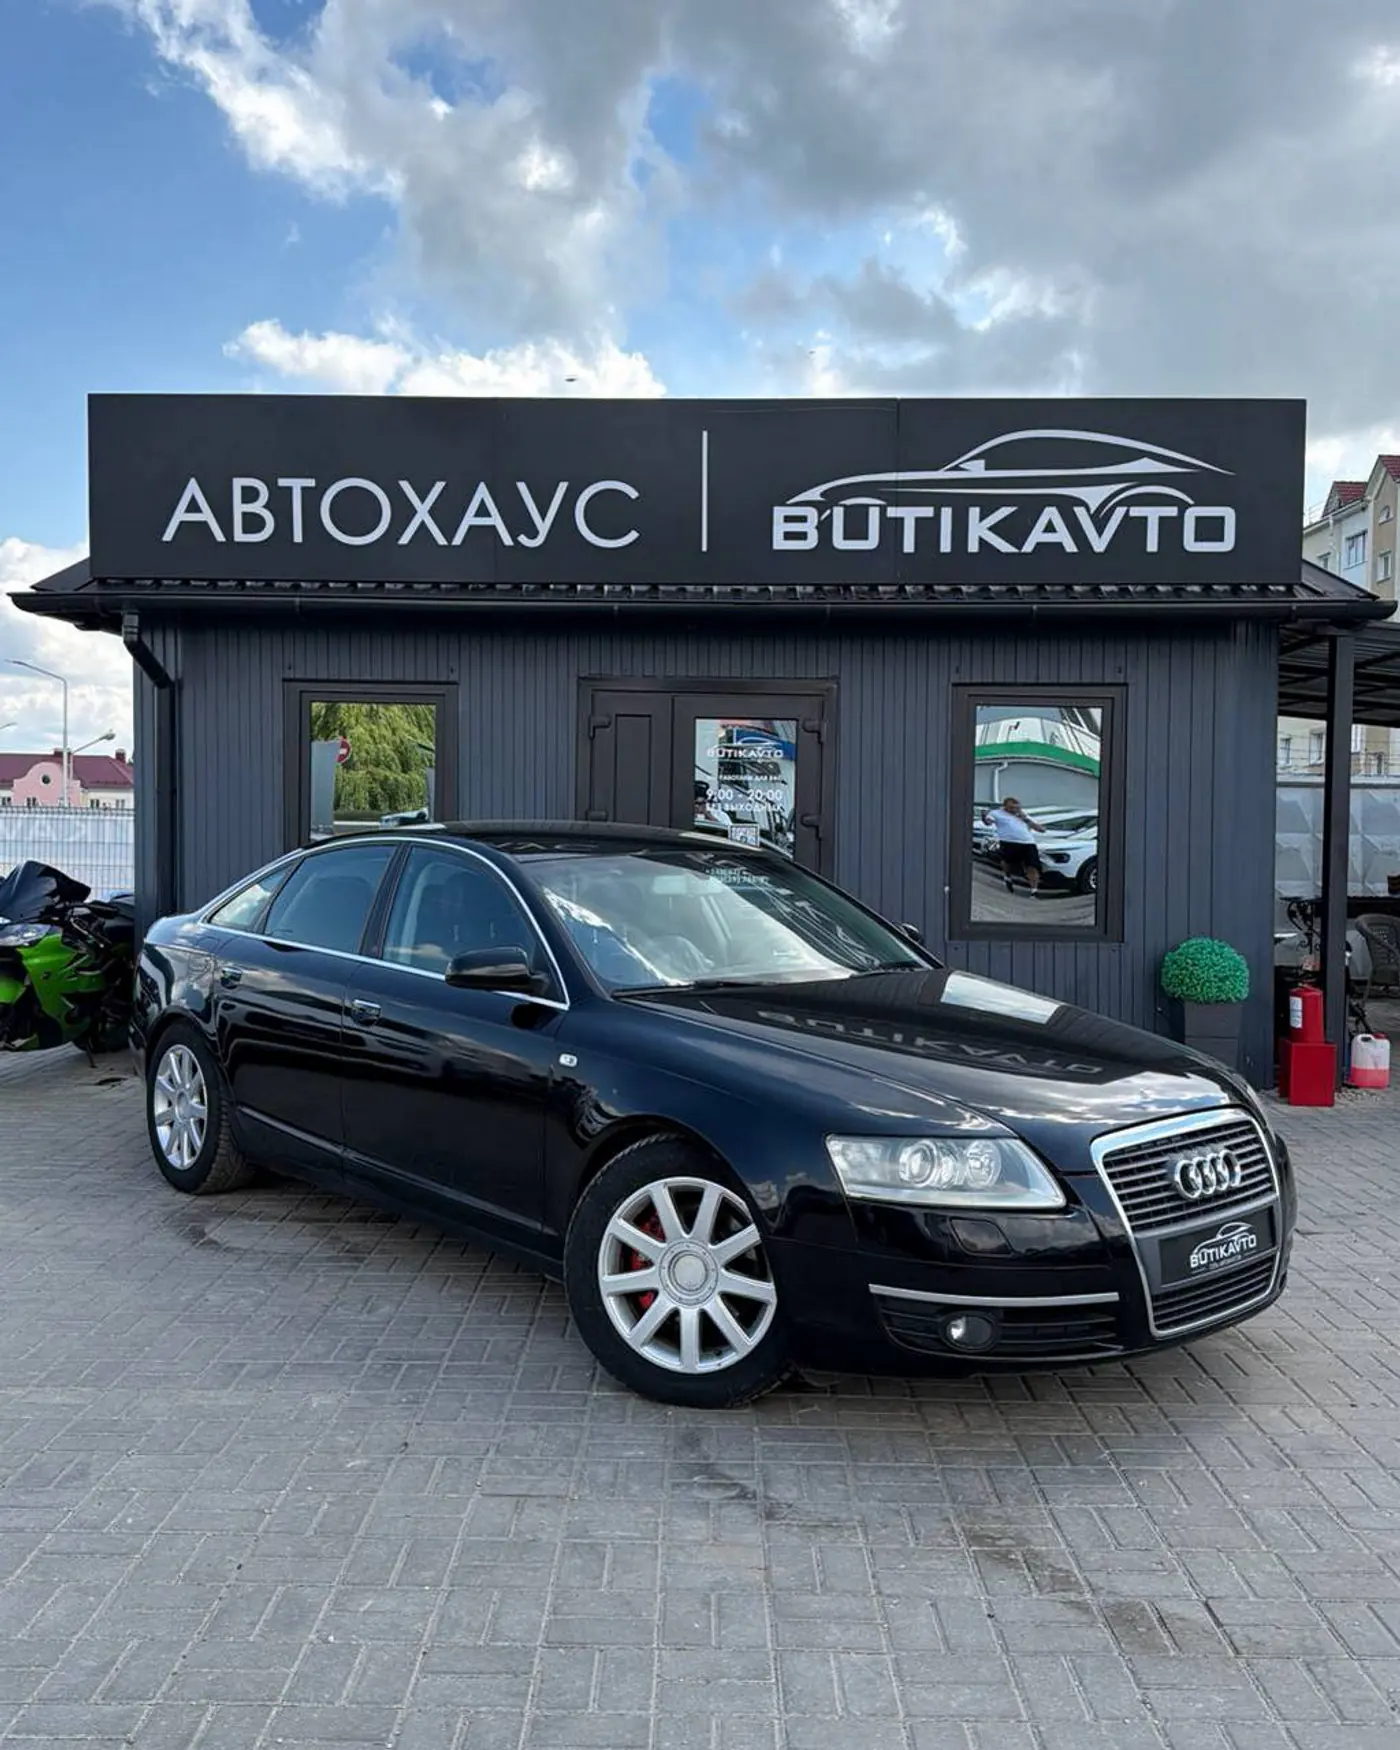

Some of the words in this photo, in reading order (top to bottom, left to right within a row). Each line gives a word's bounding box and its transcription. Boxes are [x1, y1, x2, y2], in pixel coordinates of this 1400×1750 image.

[162, 477, 639, 549] АВТОХАУС
[772, 506, 1236, 554] BUTIKAVTO
[1189, 1234, 1257, 1269] BUTIKAVTO
